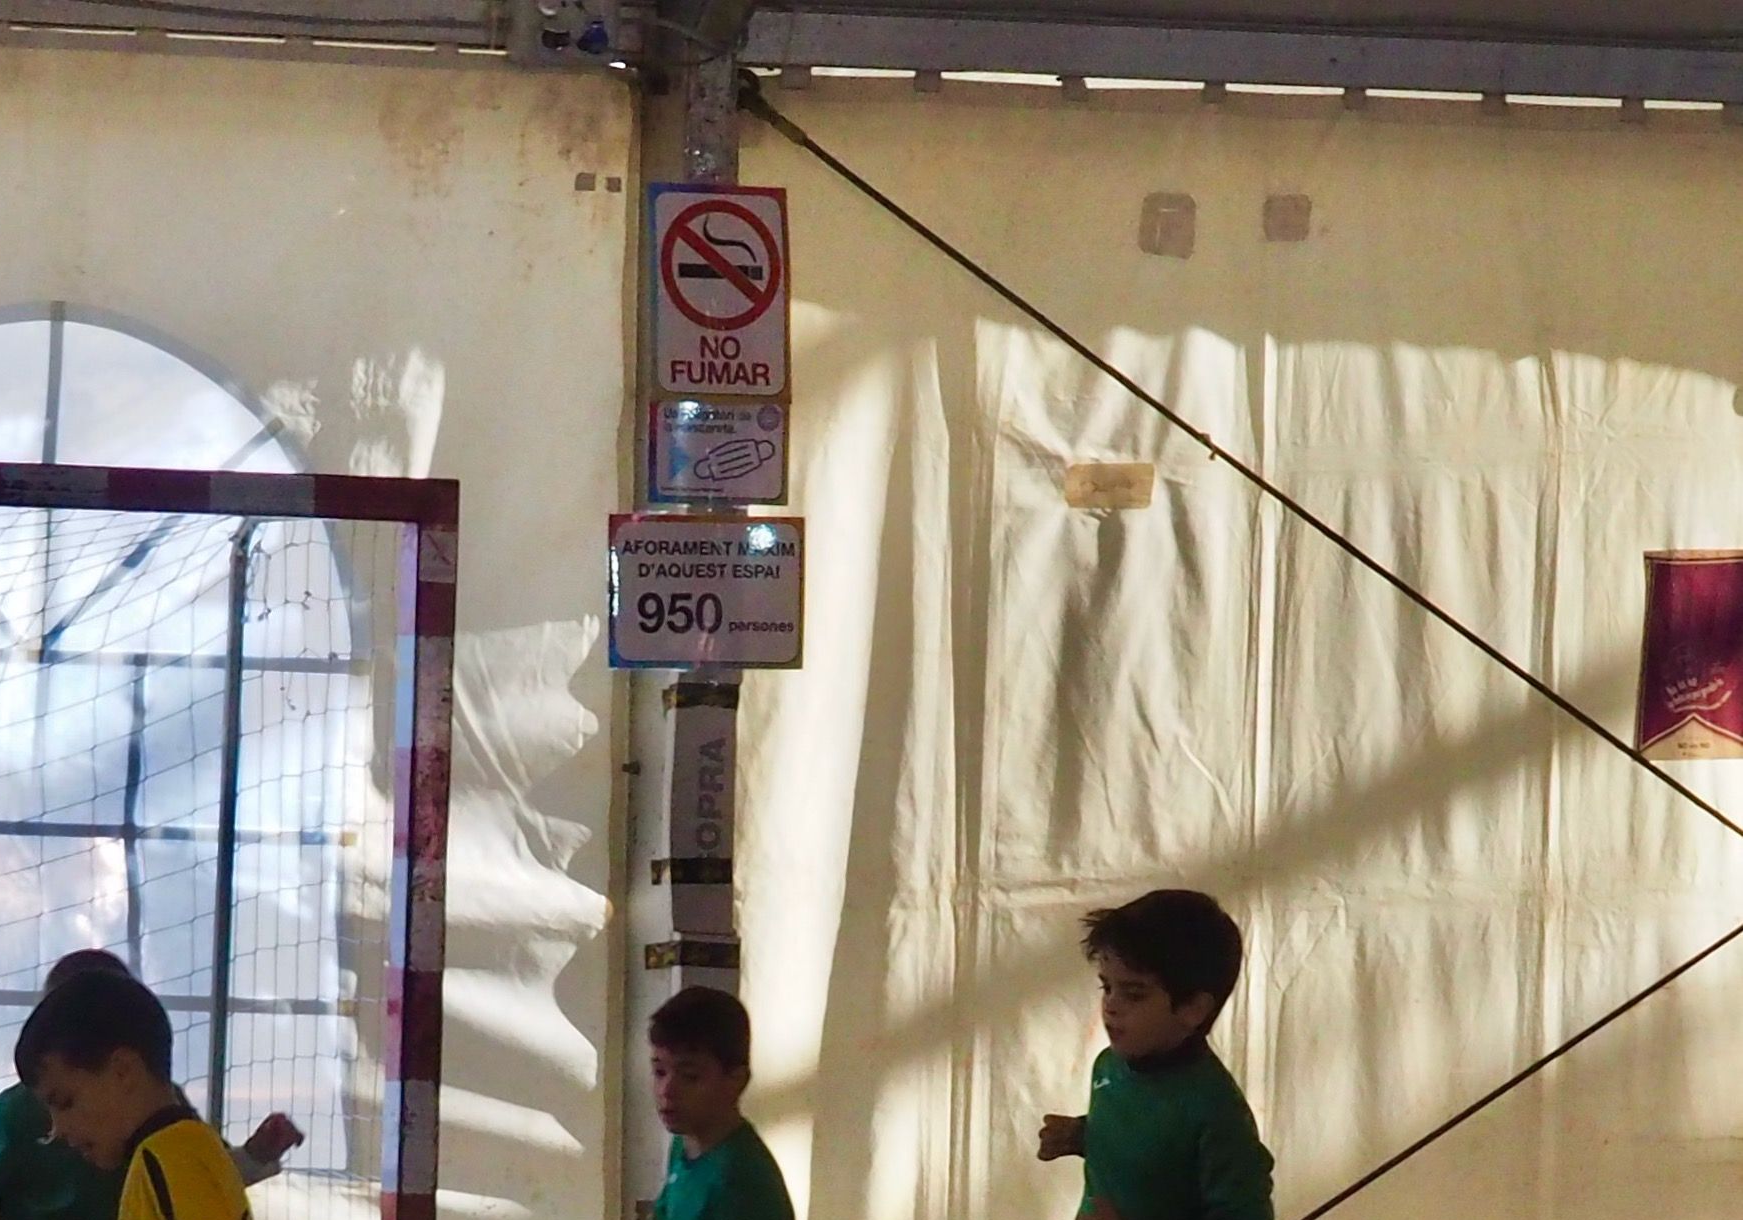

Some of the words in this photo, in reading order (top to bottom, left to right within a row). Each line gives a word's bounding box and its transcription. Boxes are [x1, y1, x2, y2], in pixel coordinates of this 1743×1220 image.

[700, 337, 740, 359] NO
[670, 360, 771, 386] FUMAR
[622, 540, 733, 557] AFORAMENT
[738, 541, 795, 557] MXIM
[638, 563, 728, 579] D'AQUEST
[732, 564, 781, 580] ESPAI
[636, 592, 724, 634] 950
[728, 621, 794, 634] persones
